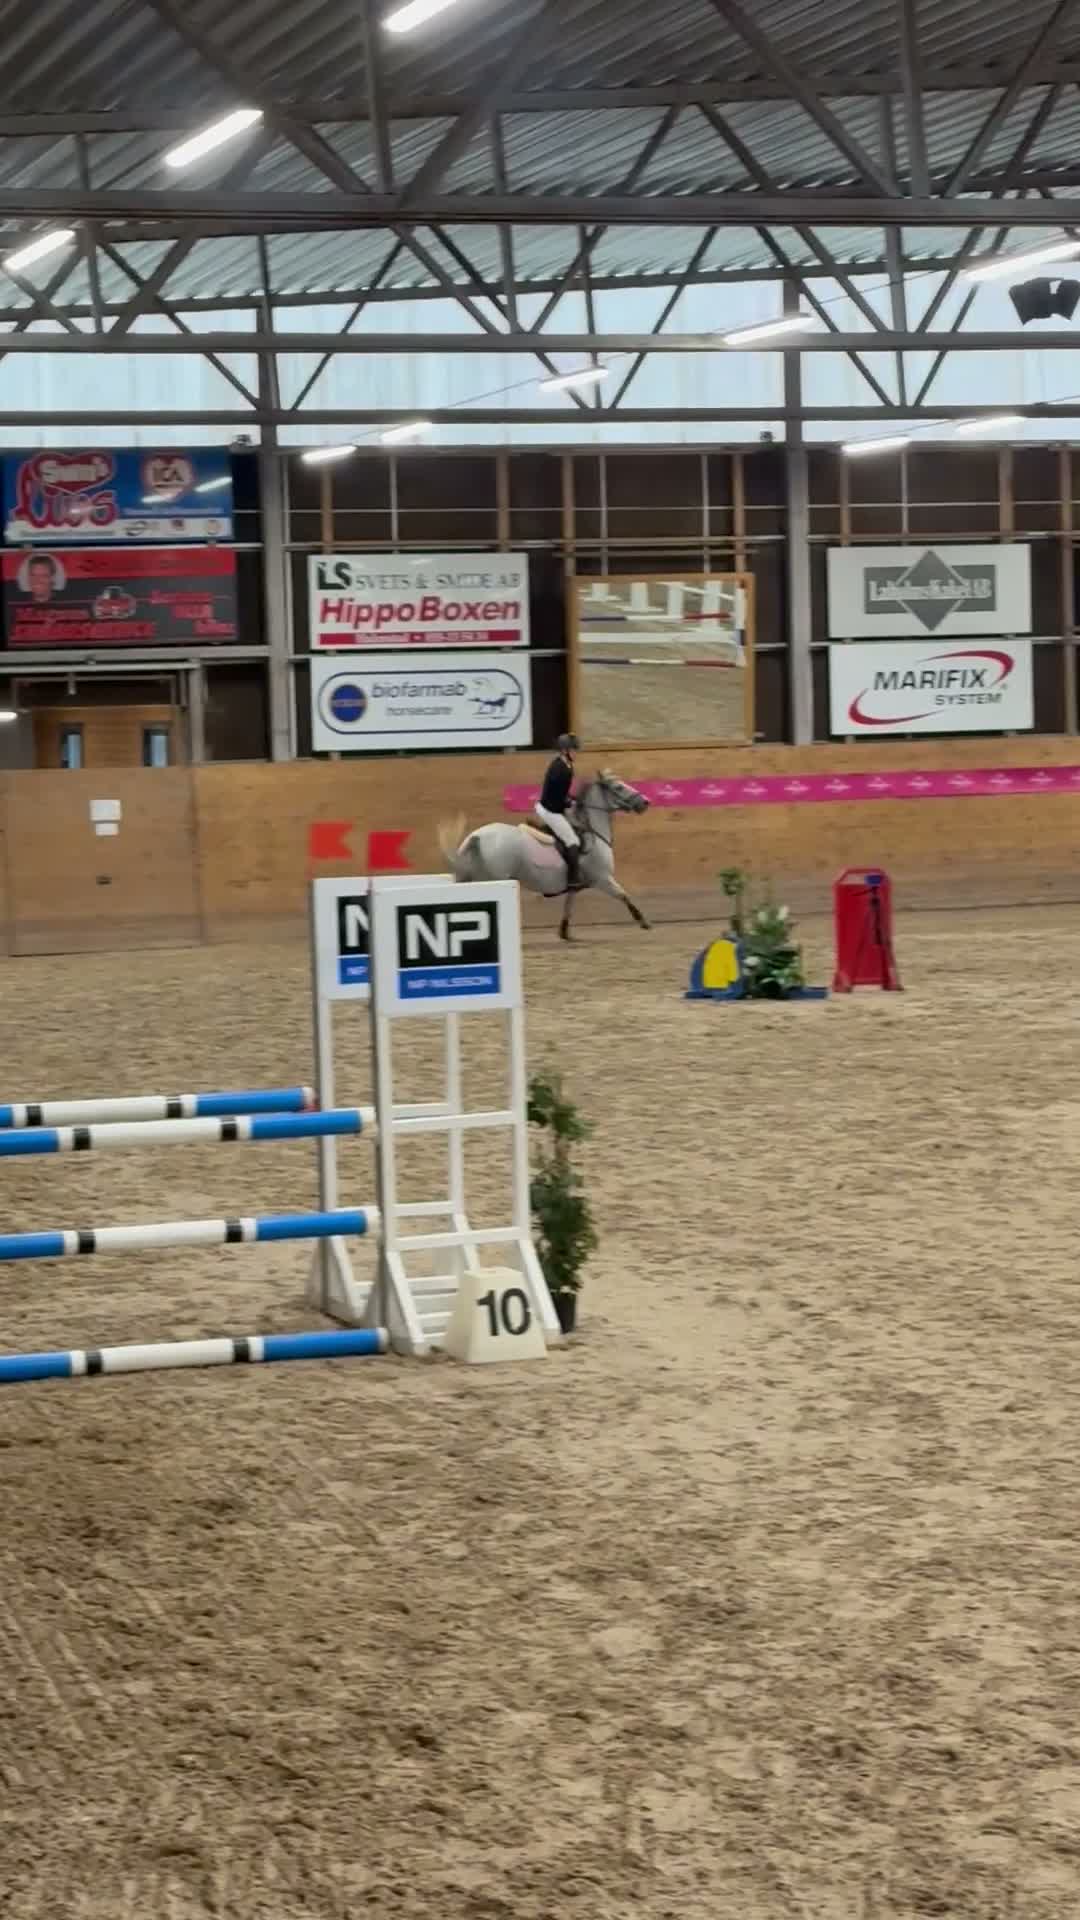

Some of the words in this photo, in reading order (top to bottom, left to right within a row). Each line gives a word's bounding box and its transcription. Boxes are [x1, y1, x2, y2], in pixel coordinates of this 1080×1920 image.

[371, 680, 467, 698] biofarmab
[873, 668, 988, 691] MARIFIX
[935, 693, 1003, 706] SYSTEM
[405, 910, 491, 960] NP
[477, 1287, 531, 1336] 10
